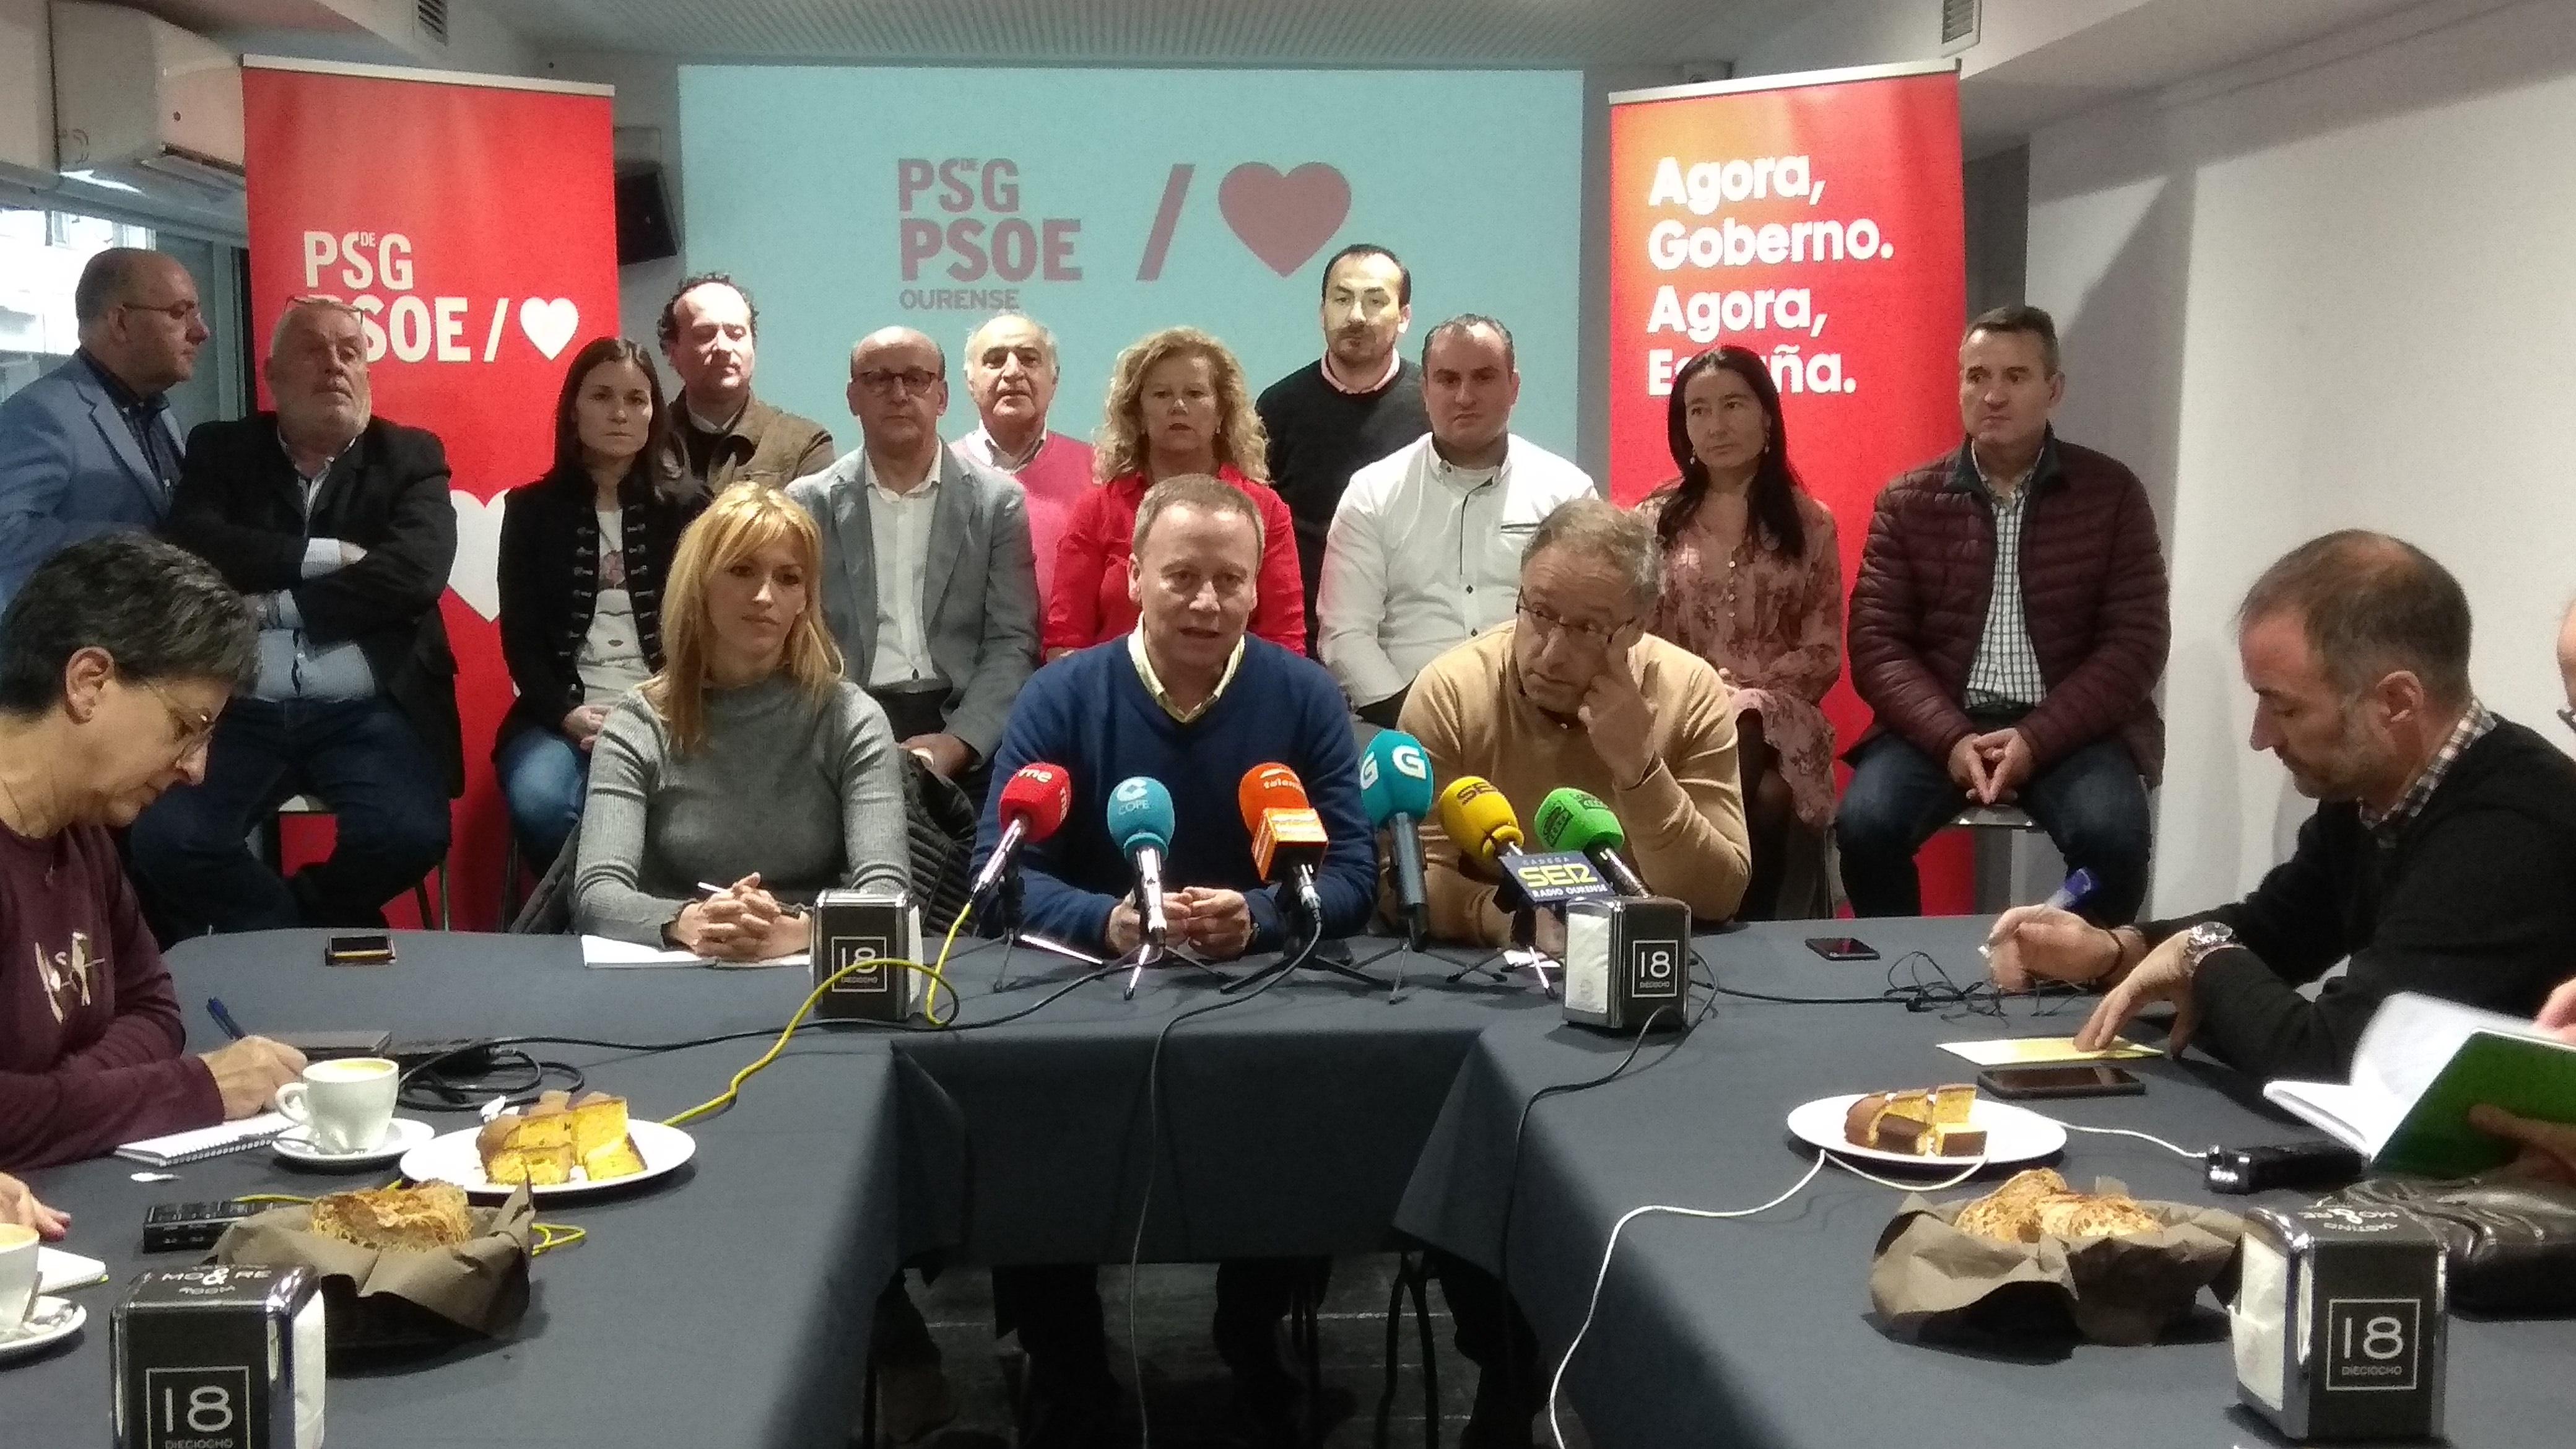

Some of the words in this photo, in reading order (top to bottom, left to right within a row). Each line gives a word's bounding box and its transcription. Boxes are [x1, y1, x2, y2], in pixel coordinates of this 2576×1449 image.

[898, 157, 1019, 213] PSG
[1648, 155, 1826, 215] Agora,
[303, 230, 414, 291] PSG
[360, 232, 376, 248] DE
[900, 217, 1083, 282] PSOE
[1647, 217, 1895, 271] Goberno.
[900, 289, 1020, 310] OURENSE
[1647, 284, 1828, 344] Agora,
[308, 294, 472, 363] SOE
[1648, 344, 1857, 396] Eña.
[1518, 863, 1598, 887] SER
[1531, 887, 1564, 898] RADIO
[1565, 883, 1608, 895] OURENSE
[1641, 950, 1671, 978] 18
[2343, 1316, 2404, 1360] 18
[165, 1385, 233, 1433] 18
